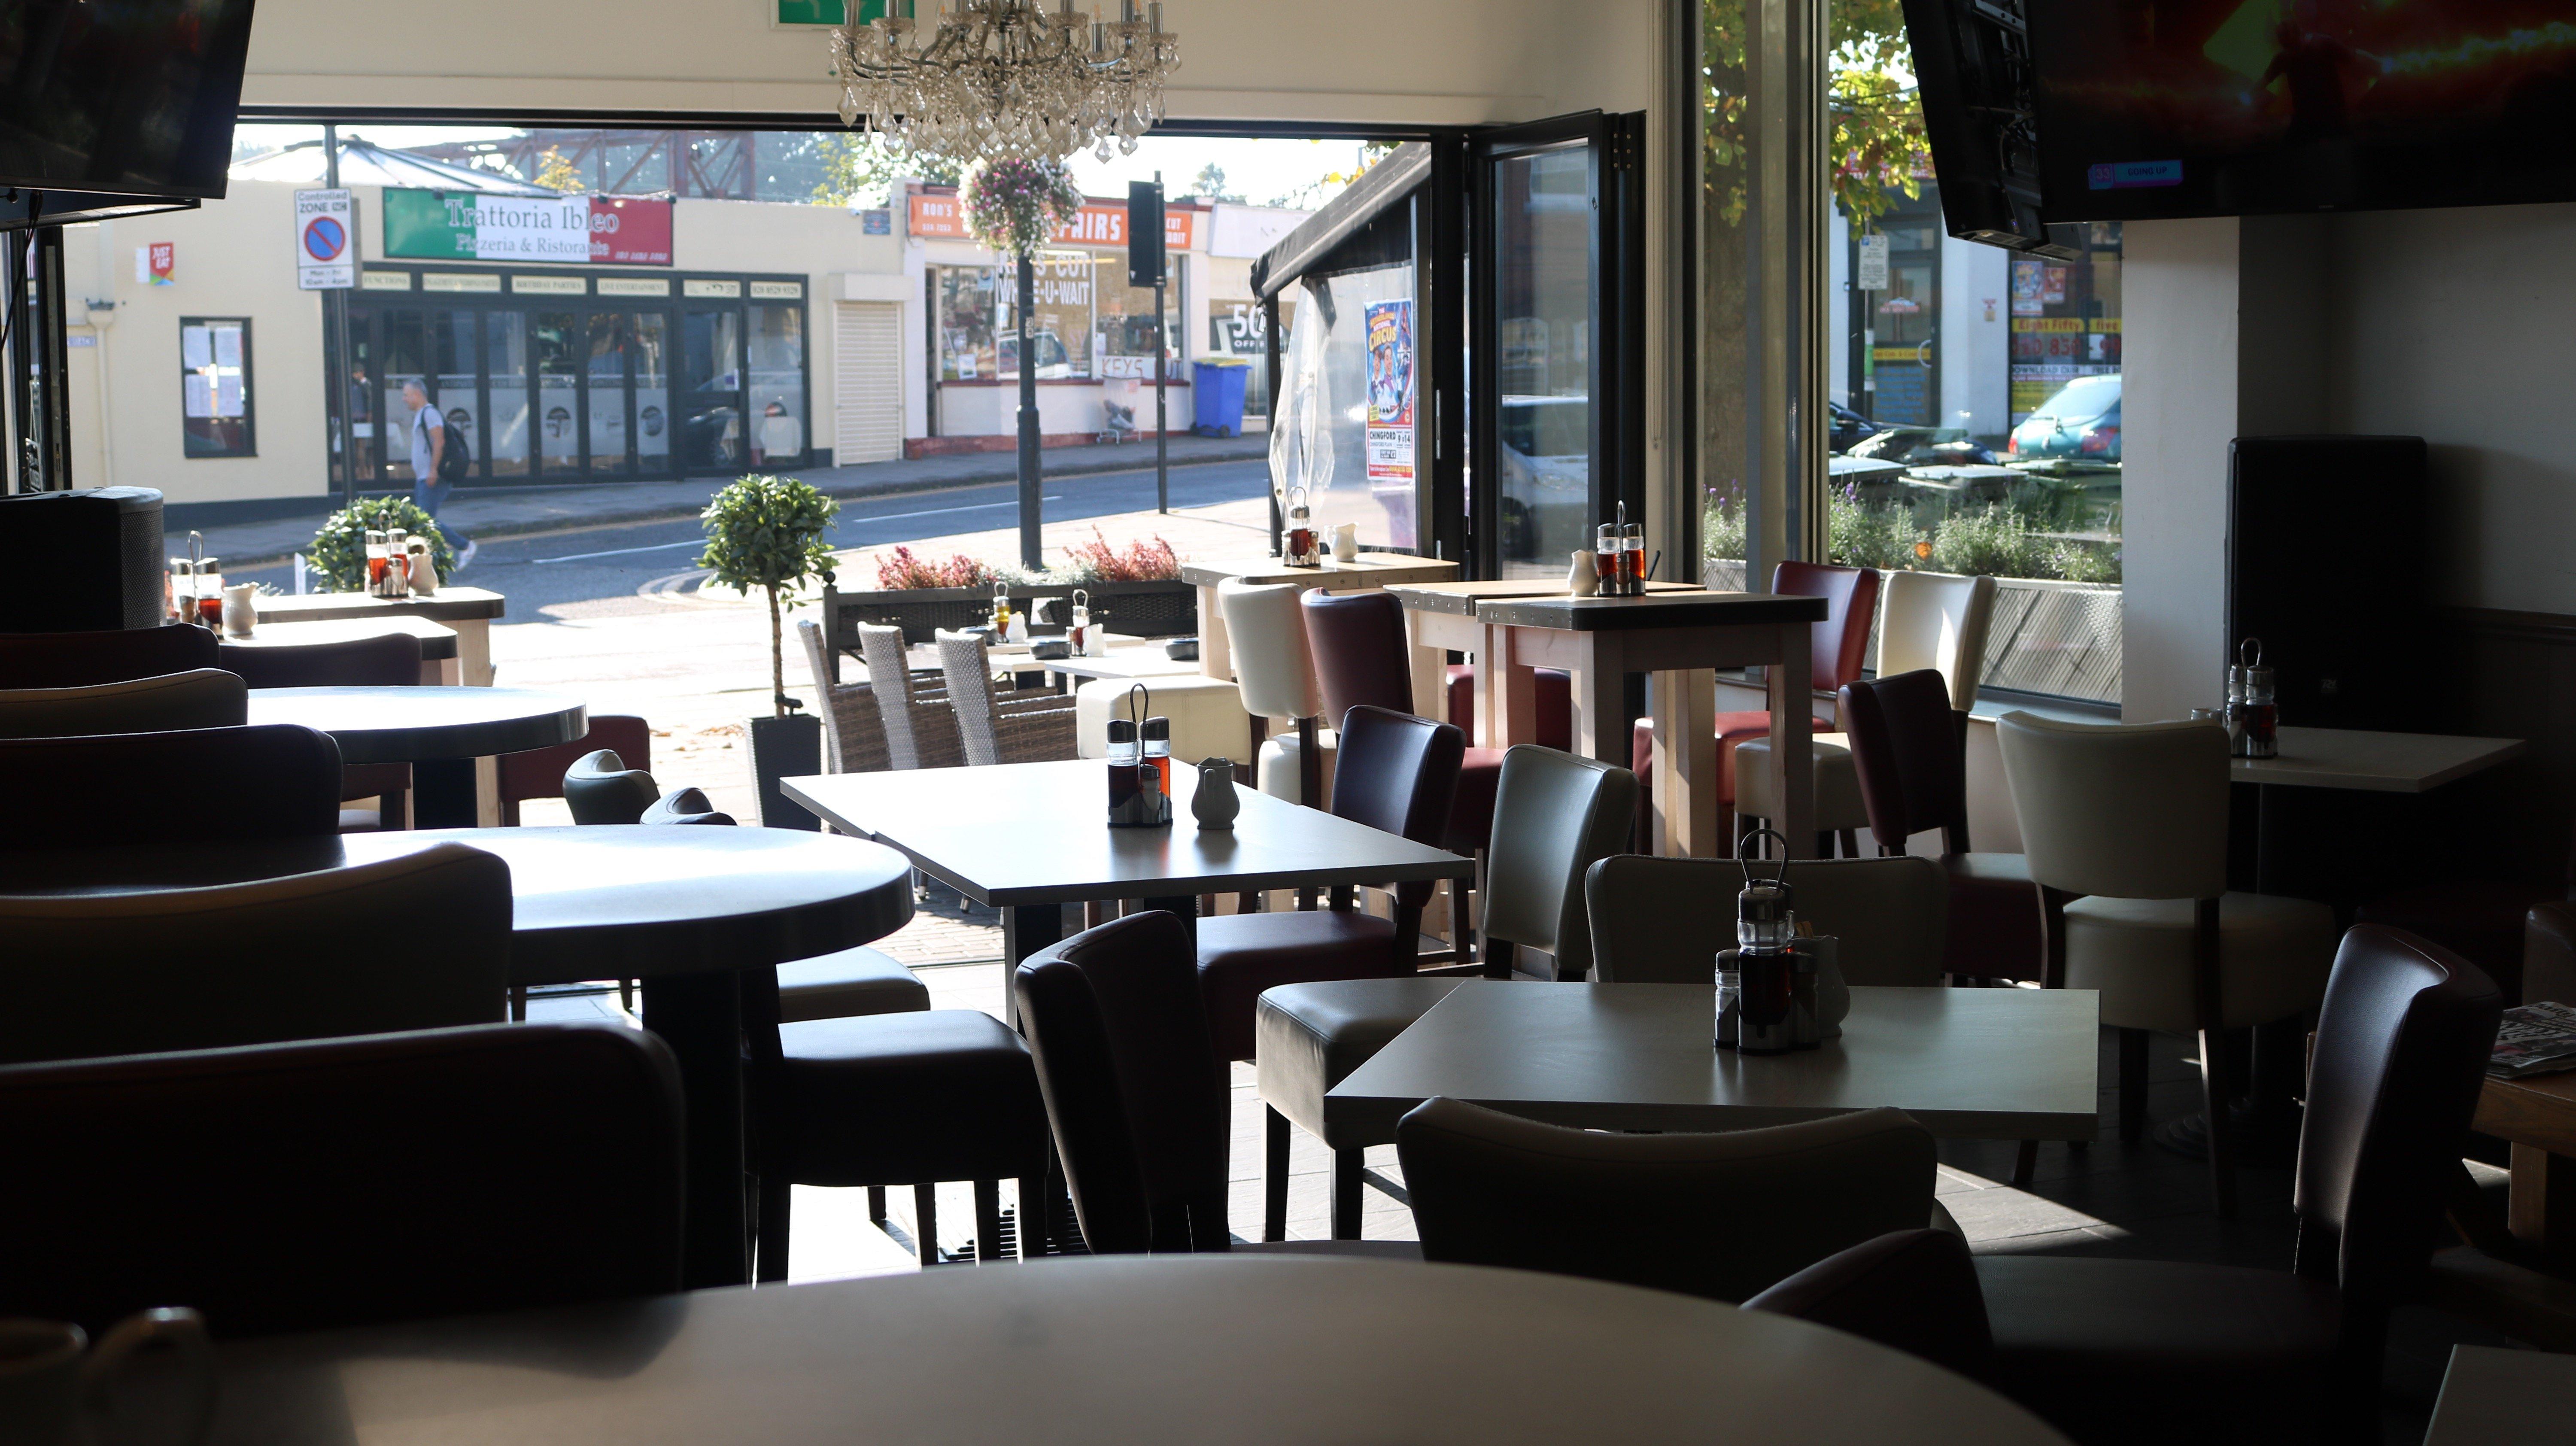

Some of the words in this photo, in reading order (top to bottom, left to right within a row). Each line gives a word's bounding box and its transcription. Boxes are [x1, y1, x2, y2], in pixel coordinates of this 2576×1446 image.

[2096, 168, 2110, 179] 33
[2128, 167, 2154, 176] GOING
[2155, 166, 2167, 174] UP
[298, 191, 347, 200] Controlled
[299, 202, 328, 213] ZONE
[444, 199, 551, 228] Trattoria
[562, 206, 620, 234] Ibleo
[1051, 212, 1121, 240] PAIRS
[1166, 217, 1181, 229] CUT
[456, 233, 515, 251] Pizzeria
[520, 237, 532, 252] &
[538, 237, 610, 256] Ristorante
[1055, 254, 1090, 278] CUT
[1233, 304, 1283, 338] 50
[2019, 319, 2048, 331] Eight
[2053, 319, 2079, 331] Fifty
[1233, 340, 1255, 348] OFF
[1368, 326, 1397, 352] CIRCUS
[1102, 358, 1143, 377] KEYS
[1154, 359, 1182, 379] UT
[1370, 431, 1396, 440] CHINGFORD
